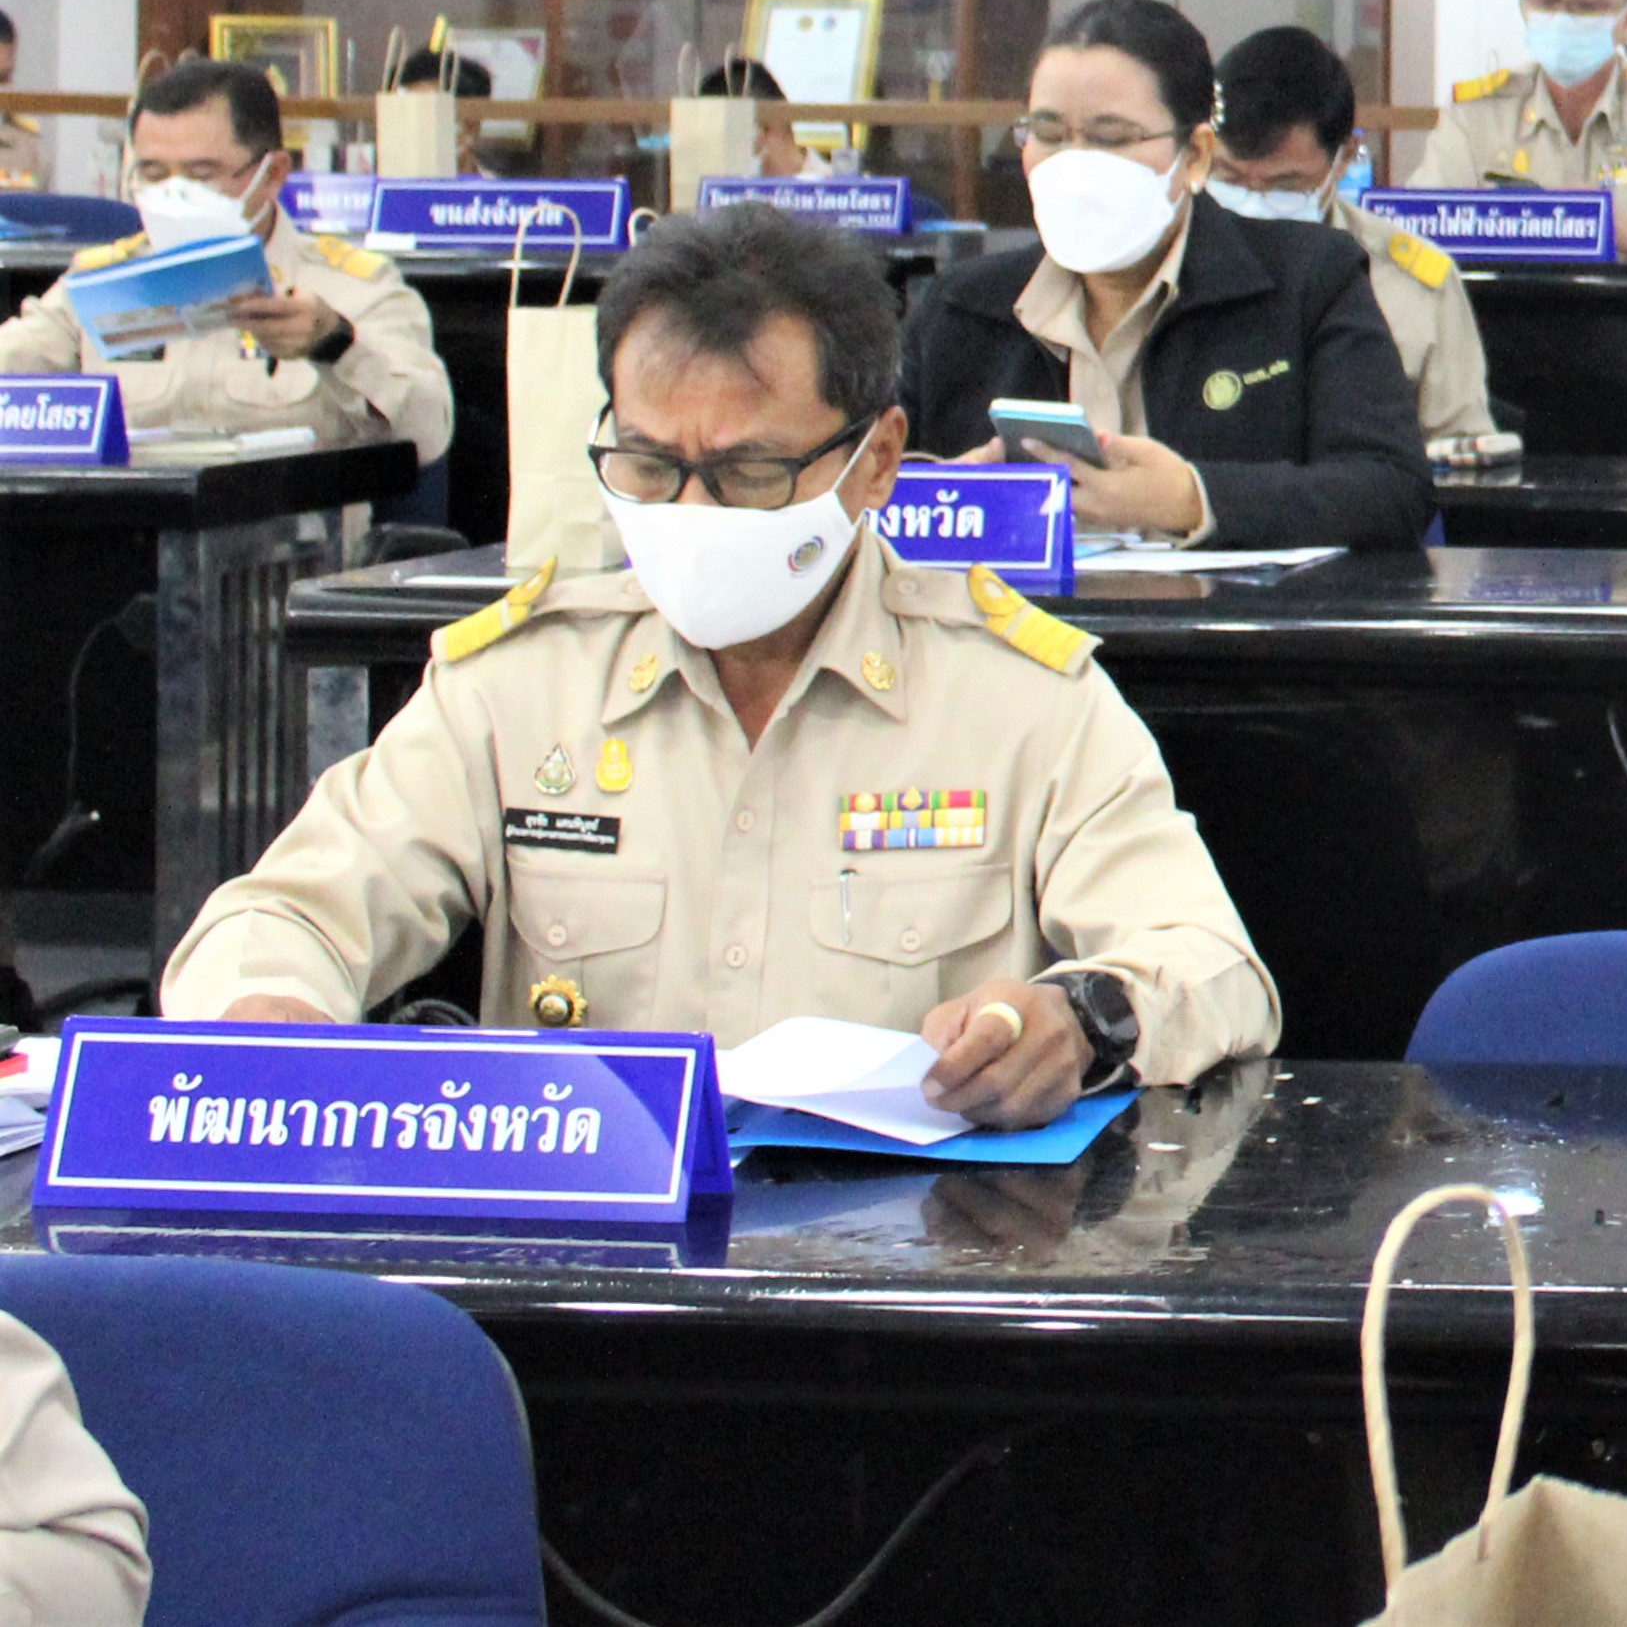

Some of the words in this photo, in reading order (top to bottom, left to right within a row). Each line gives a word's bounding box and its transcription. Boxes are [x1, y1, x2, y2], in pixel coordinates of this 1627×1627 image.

[148, 1072, 602, 1156] พัฒนาการจังหวัด
